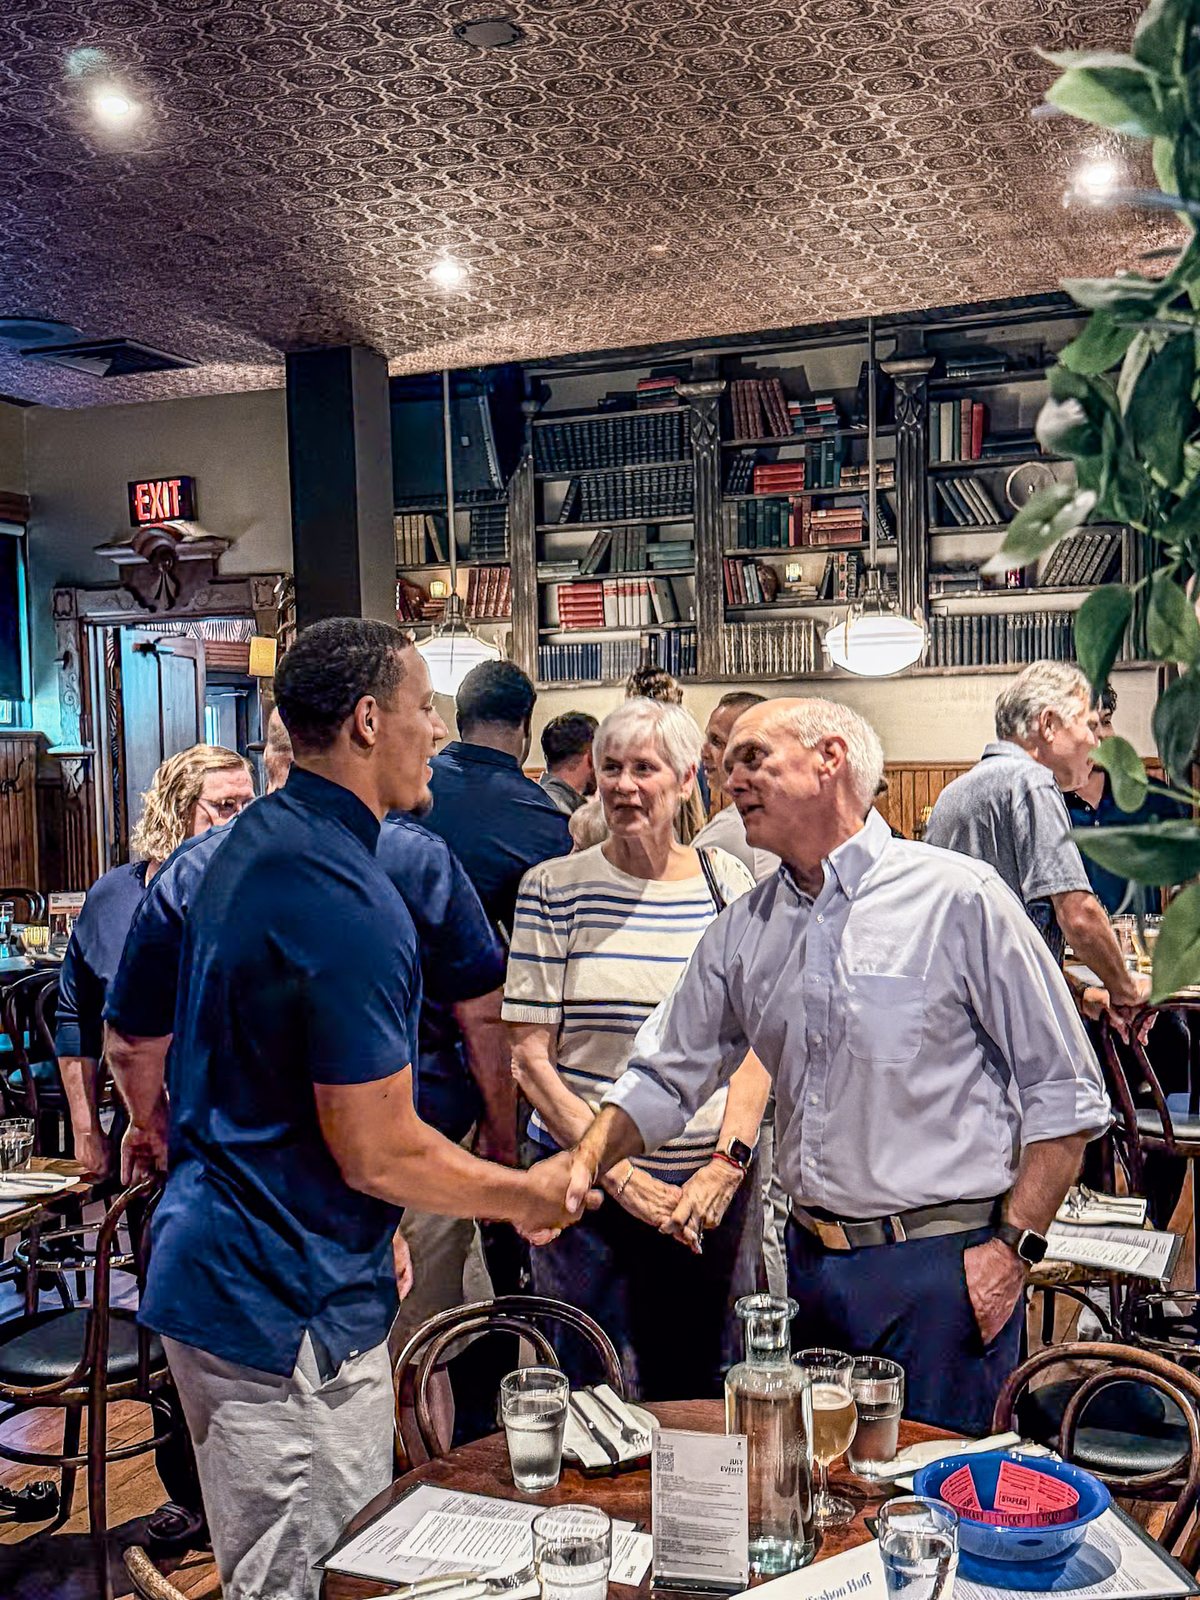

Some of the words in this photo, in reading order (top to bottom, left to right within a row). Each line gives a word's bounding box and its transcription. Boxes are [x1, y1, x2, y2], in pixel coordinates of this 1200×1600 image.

[136, 480, 181, 520] EXIT
[729, 1458, 744, 1466] JULY
[720, 1465, 744, 1474] EVENTS
[1001, 1513, 1026, 1524] TICKET
[846, 1571, 872, 1593] Huff
